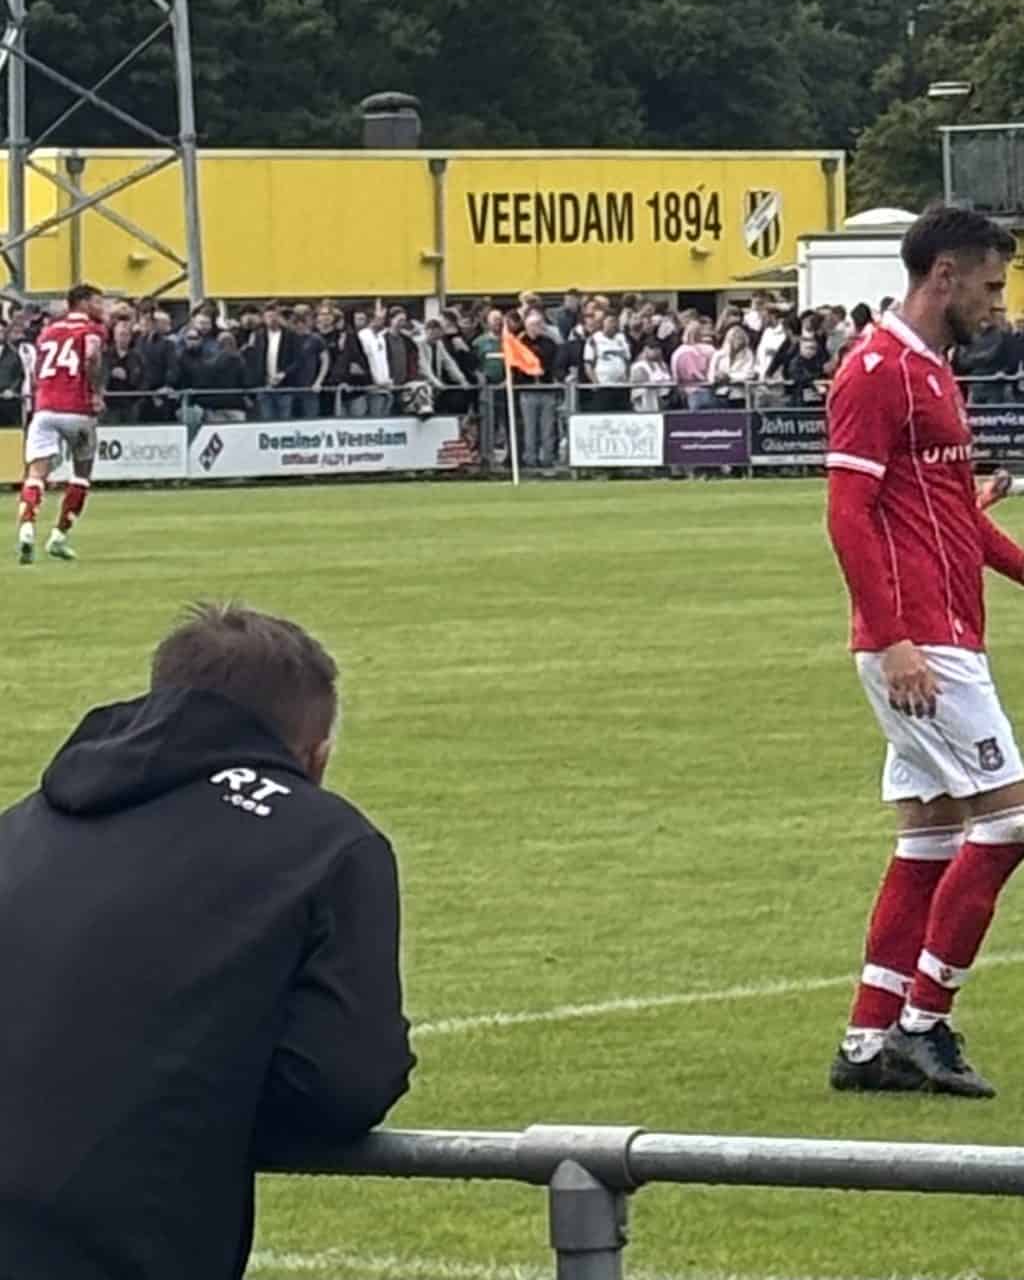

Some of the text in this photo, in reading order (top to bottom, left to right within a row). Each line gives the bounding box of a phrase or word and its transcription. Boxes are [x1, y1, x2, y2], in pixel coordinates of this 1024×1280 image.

[467, 191, 634, 244] VEENDAM
[646, 191, 722, 243] 1894
[39, 336, 80, 379] 24
[259, 428, 408, 450] Domino's Veendam
[759, 417, 794, 435] John
[210, 767, 291, 800] RT
